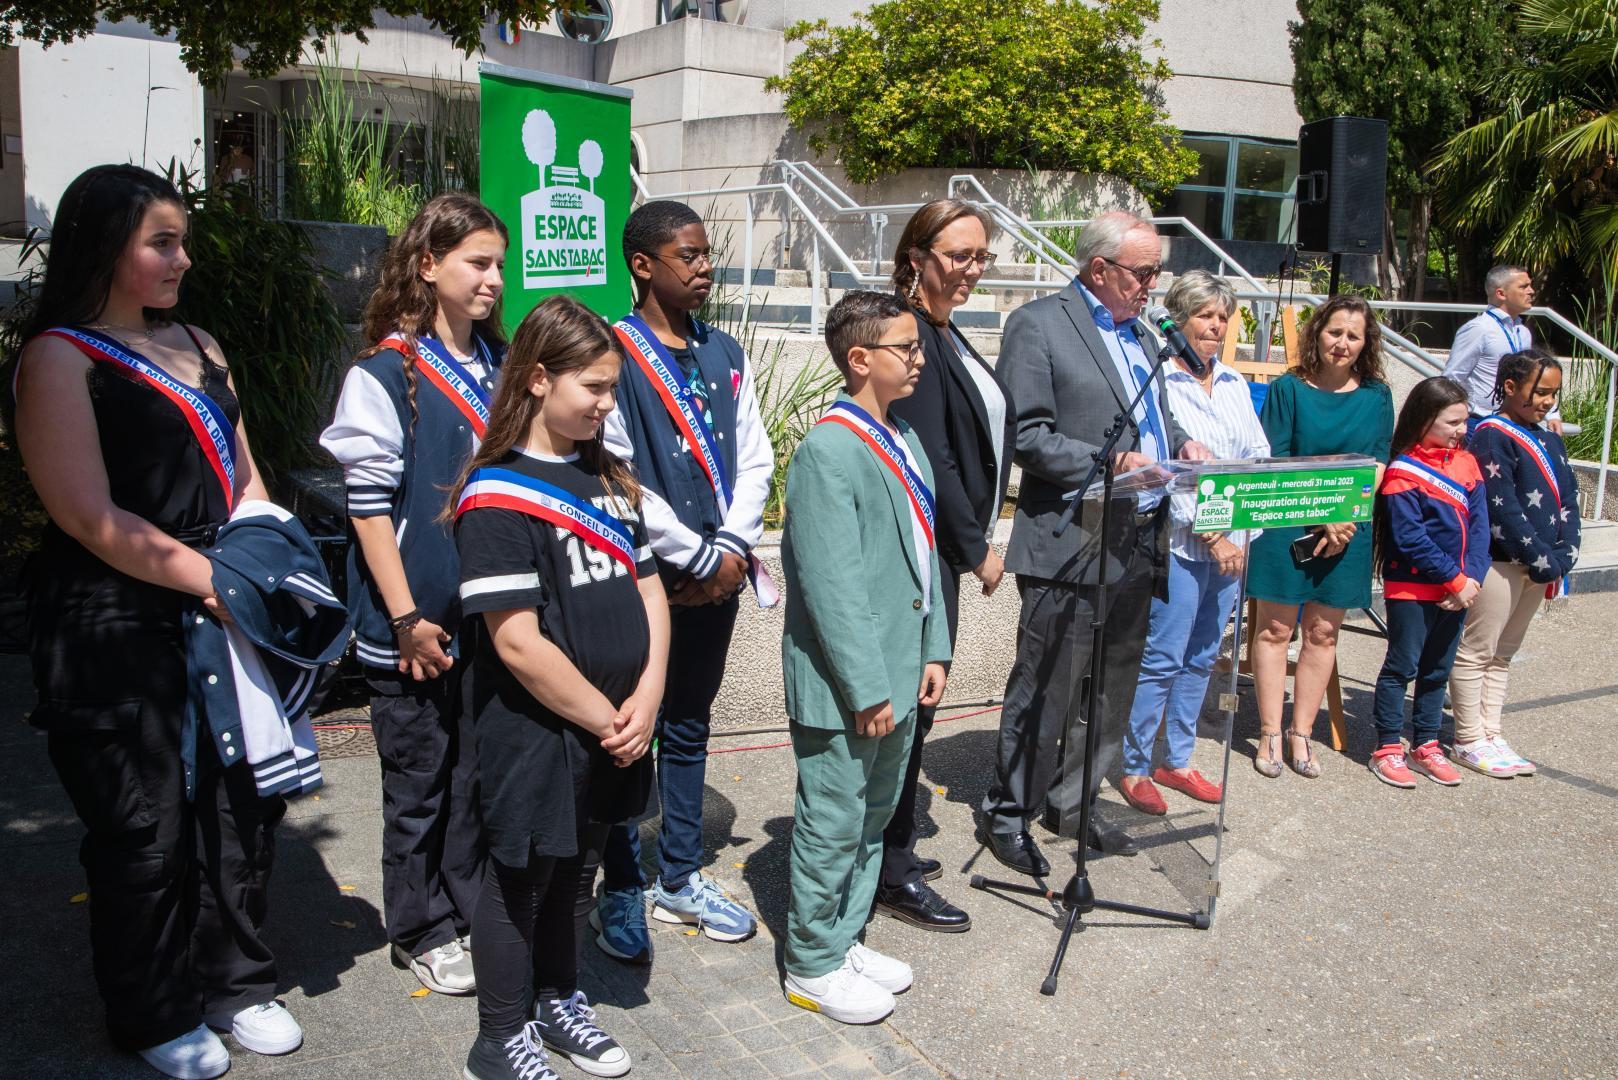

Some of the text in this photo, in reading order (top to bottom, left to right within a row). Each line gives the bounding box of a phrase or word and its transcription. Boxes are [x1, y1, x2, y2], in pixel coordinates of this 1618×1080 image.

[535, 215, 597, 240] ESPACE
[417, 346, 463, 391] CONSEIL
[74, 331, 141, 371] CONSEIL
[145, 367, 211, 429] MUNICIPAL
[210, 427, 227, 454] DES
[619, 323, 720, 486] CONSEIL MUNICIPAL DES JEUNES
[867, 427, 904, 470] CONSEIL
[1511, 428, 1535, 448] CONSEIL
[1237, 480, 1277, 492] Argenteuil
[1282, 478, 1315, 489] mercredi
[1315, 479, 1323, 487] 31
[1324, 478, 1337, 487] mai
[1337, 477, 1354, 486] 2023
[1438, 481, 1462, 501] CONSEIL
[1201, 507, 1230, 517] ESPACE
[1241, 493, 1346, 510] Inauguration du premier
[559, 503, 600, 533] CONSEIL
[1284, 510, 1305, 519] sans
